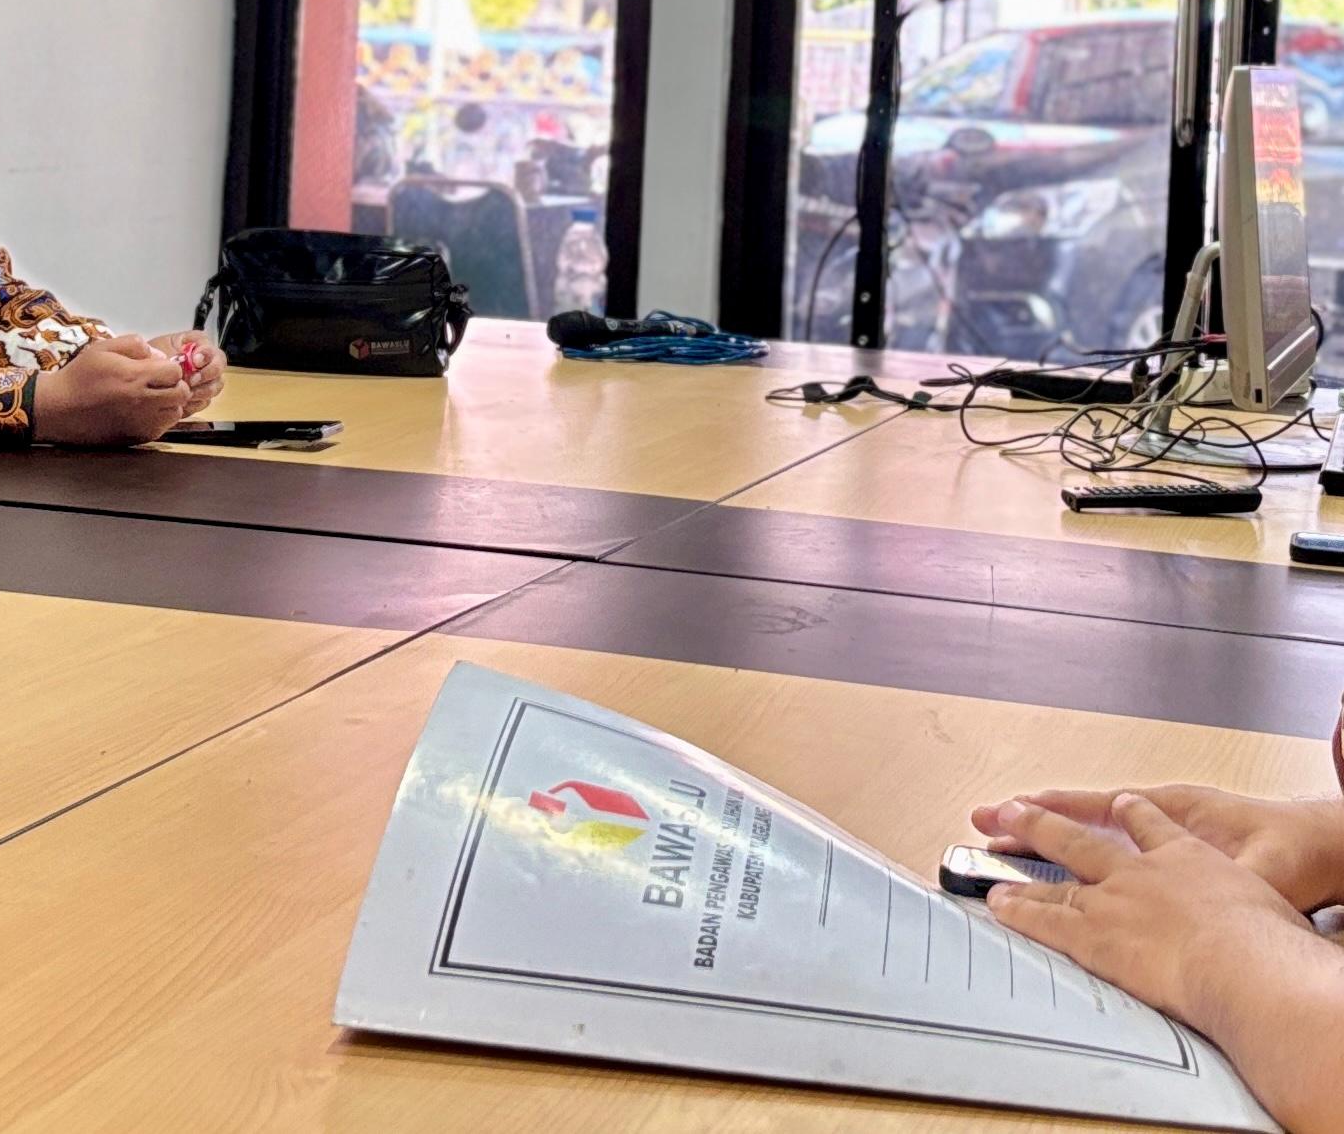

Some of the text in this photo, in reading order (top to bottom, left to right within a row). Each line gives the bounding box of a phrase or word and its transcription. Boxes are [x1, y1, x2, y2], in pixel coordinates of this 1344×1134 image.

[370, 339, 410, 349] BAWASLU
[706, 842, 735, 910] PENGAWAS
[736, 849, 766, 920] KABUPATEN
[693, 912, 722, 970] BADAN
